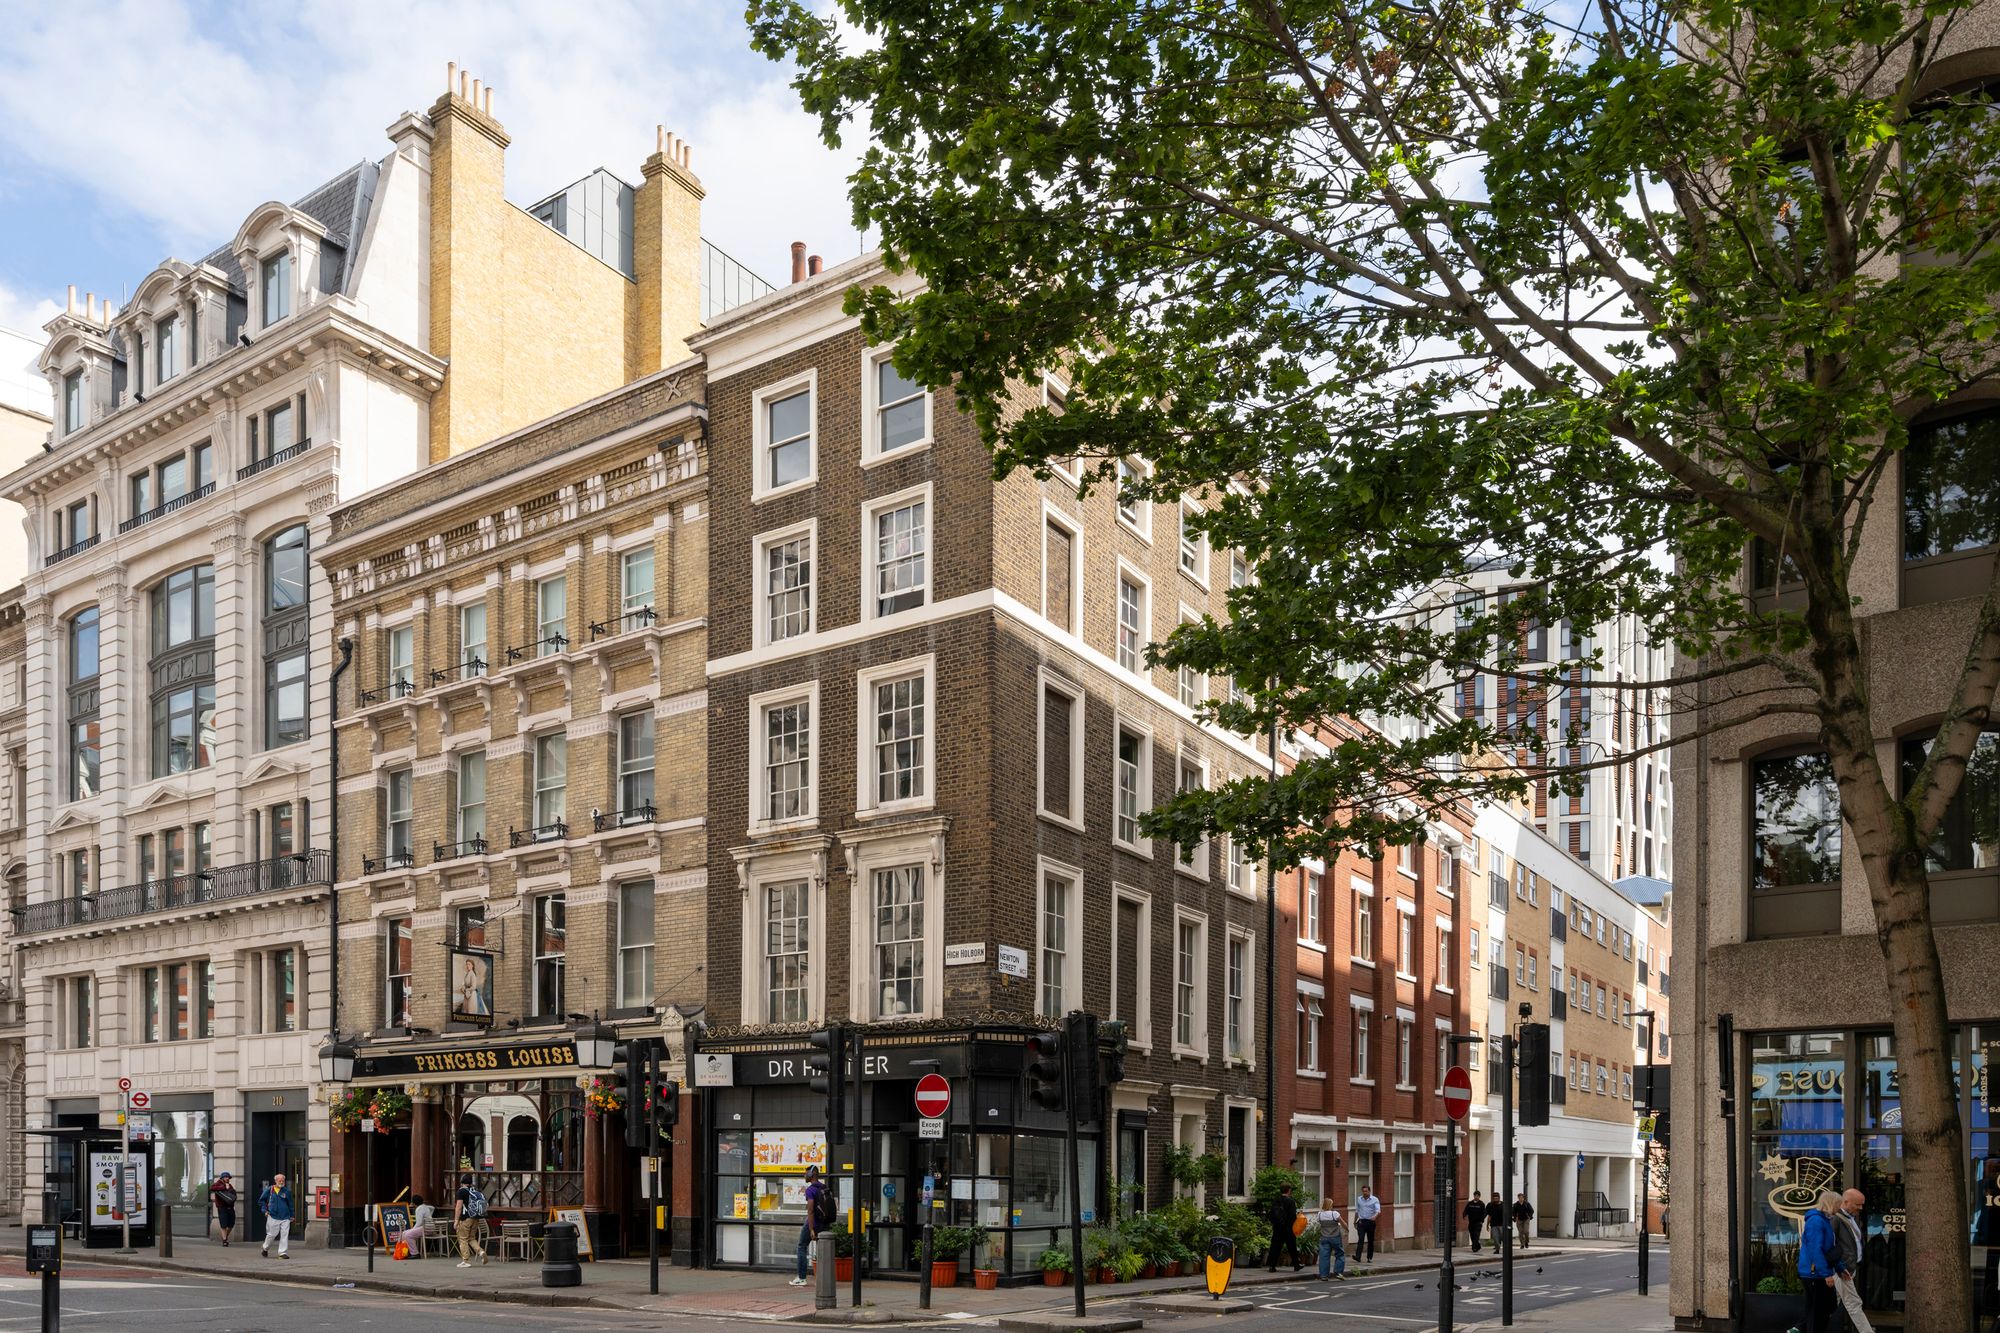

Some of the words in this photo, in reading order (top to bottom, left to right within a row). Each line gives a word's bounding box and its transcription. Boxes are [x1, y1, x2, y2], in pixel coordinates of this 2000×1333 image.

[946, 950, 960, 959] HIGH
[960, 948, 985, 958] HOLBORN
[1000, 952, 1020, 964] NEWTON
[999, 962, 1017, 972] STREET
[414, 1051, 498, 1072] PRINCESS
[508, 1046, 574, 1067] LOUISE
[768, 1060, 794, 1078] DR
[803, 1055, 889, 1077] HER
[921, 1120, 942, 1129] Except
[921, 1128, 940, 1136] cycles
